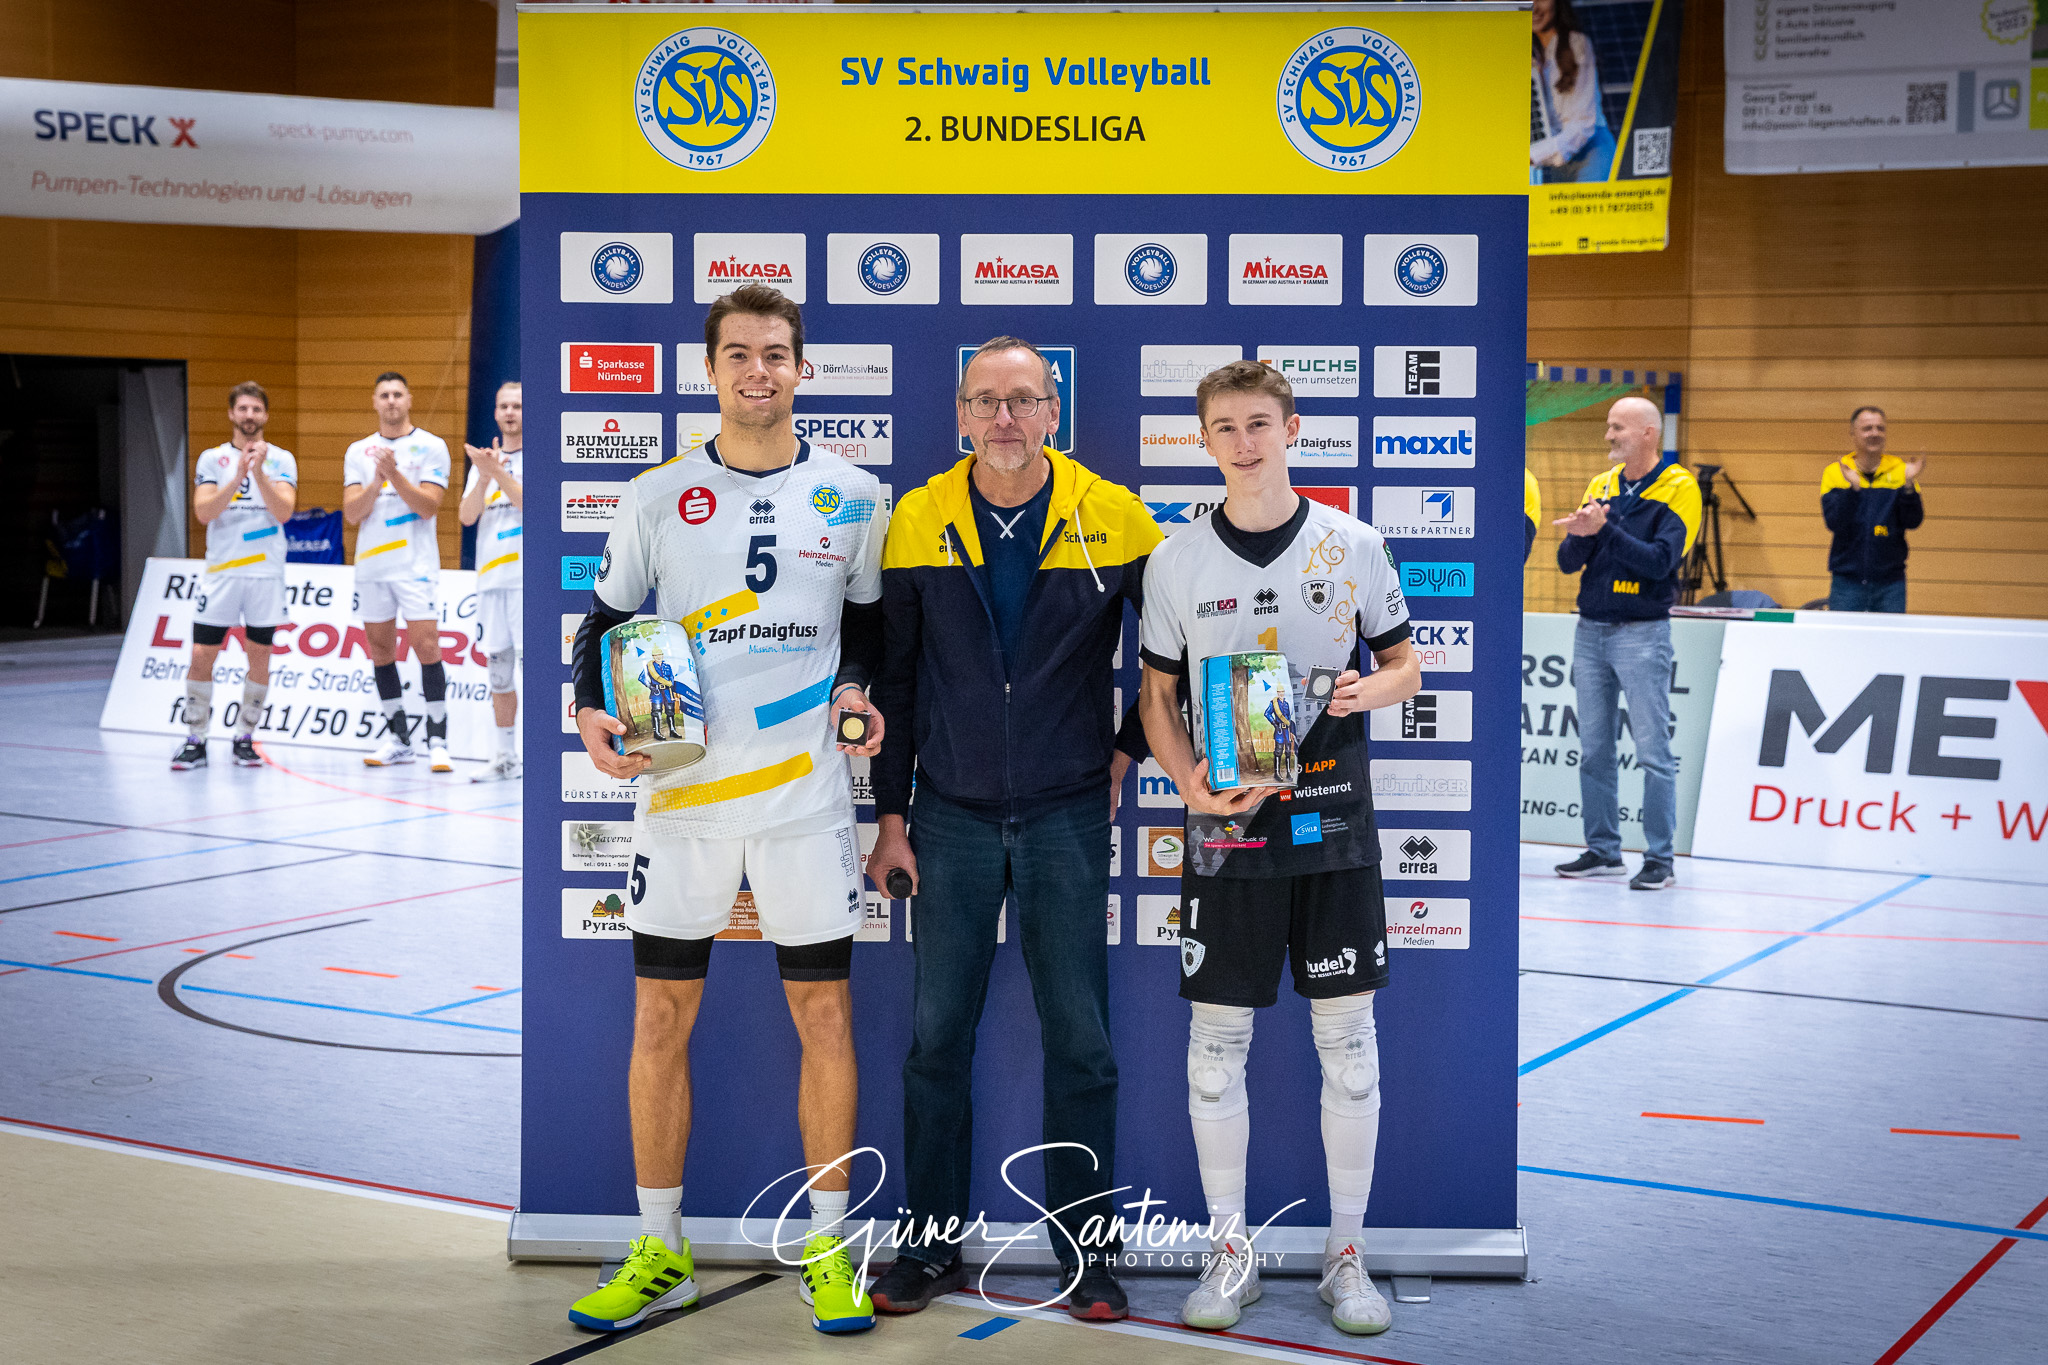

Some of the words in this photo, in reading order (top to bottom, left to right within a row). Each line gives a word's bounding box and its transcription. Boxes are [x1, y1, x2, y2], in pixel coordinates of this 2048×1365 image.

[641, 35, 691, 97] SCHWAIG
[1283, 35, 1335, 97] SCHWAIG
[716, 33, 771, 122] VOLLEYBALL
[841, 57, 884, 86] SV
[898, 57, 1030, 93] Schwaig
[1044, 57, 1211, 93] Volleyball
[1361, 33, 1416, 122] VOLLEYBALL
[640, 104, 654, 123] SV
[1283, 104, 1297, 123] SV
[35, 109, 160, 146] SPECK
[267, 121, 414, 145] speck-pumps.com
[904, 116, 931, 142] 2.
[941, 116, 1146, 142] BUNDESLIGA
[688, 153, 723, 166] 1967
[1330, 154, 1367, 166] 1967
[31, 171, 262, 204] Pumpen-Technologien
[267, 185, 306, 202] und
[310, 187, 413, 210] -Lösungen
[597, 247, 636, 265] VOLLEYBALL
[864, 248, 903, 266] VOLLEYBALL
[1131, 249, 1170, 267] VOLLEYBALL
[1401, 250, 1440, 267] VOLLEYBALL
[707, 254, 793, 278] MIKASA
[974, 255, 1060, 279] MIKASA
[1242, 255, 1329, 279] MIKASA
[598, 273, 636, 289] BUNDESLIGA
[865, 274, 903, 290] BUNDESLIGA
[1132, 275, 1170, 291] BUNDESLIGA
[1402, 276, 1440, 292] BUNDESLIGA
[597, 359, 645, 370] Sparkasse
[823, 364, 888, 373] DörrMassivHaus
[1282, 359, 1357, 372] FUCHS
[1408, 354, 1418, 391] TEAM
[597, 372, 642, 383] Nürnberg
[1286, 376, 1307, 384] deen
[1310, 376, 1357, 385] umsetzen
[678, 383, 712, 391] FÜRST
[794, 419, 866, 439] SPECK
[566, 435, 658, 447] BAUMÜLLER
[1300, 438, 1352, 450] Daigfuss
[1375, 430, 1473, 456] maxit
[576, 448, 649, 459] SERVICES
[749, 515, 775, 525] errea
[1064, 530, 1107, 544] Schwaig
[1411, 527, 1418, 535] &
[1421, 527, 1471, 535] PARTNER
[798, 549, 847, 562] Heinzelmann
[744, 534, 778, 594] 5
[815, 560, 834, 568] Medien
[1408, 568, 1466, 592] DYN
[1612, 579, 1640, 595] MM
[1196, 601, 1216, 613] JUST
[1253, 604, 1279, 615] errea
[708, 625, 747, 644] Zapf
[749, 622, 818, 640] Daigfuss
[1257, 626, 1279, 651] 1
[309, 666, 376, 694] Straße
[1305, 759, 1337, 773] LAPP
[564, 789, 599, 799] FÜRST
[601, 791, 608, 799] &
[1294, 781, 1352, 798] wüstenrot
[1748, 785, 1917, 834] Druck
[1941, 803, 1973, 832] +
[1301, 825, 1318, 834] SWLB
[595, 833, 633, 843] Taverna
[1399, 861, 1438, 874] errea
[630, 852, 651, 905] 5
[1189, 897, 1200, 930] 1
[1386, 922, 1462, 936] einzelmann
[1402, 936, 1435, 946] Medien
